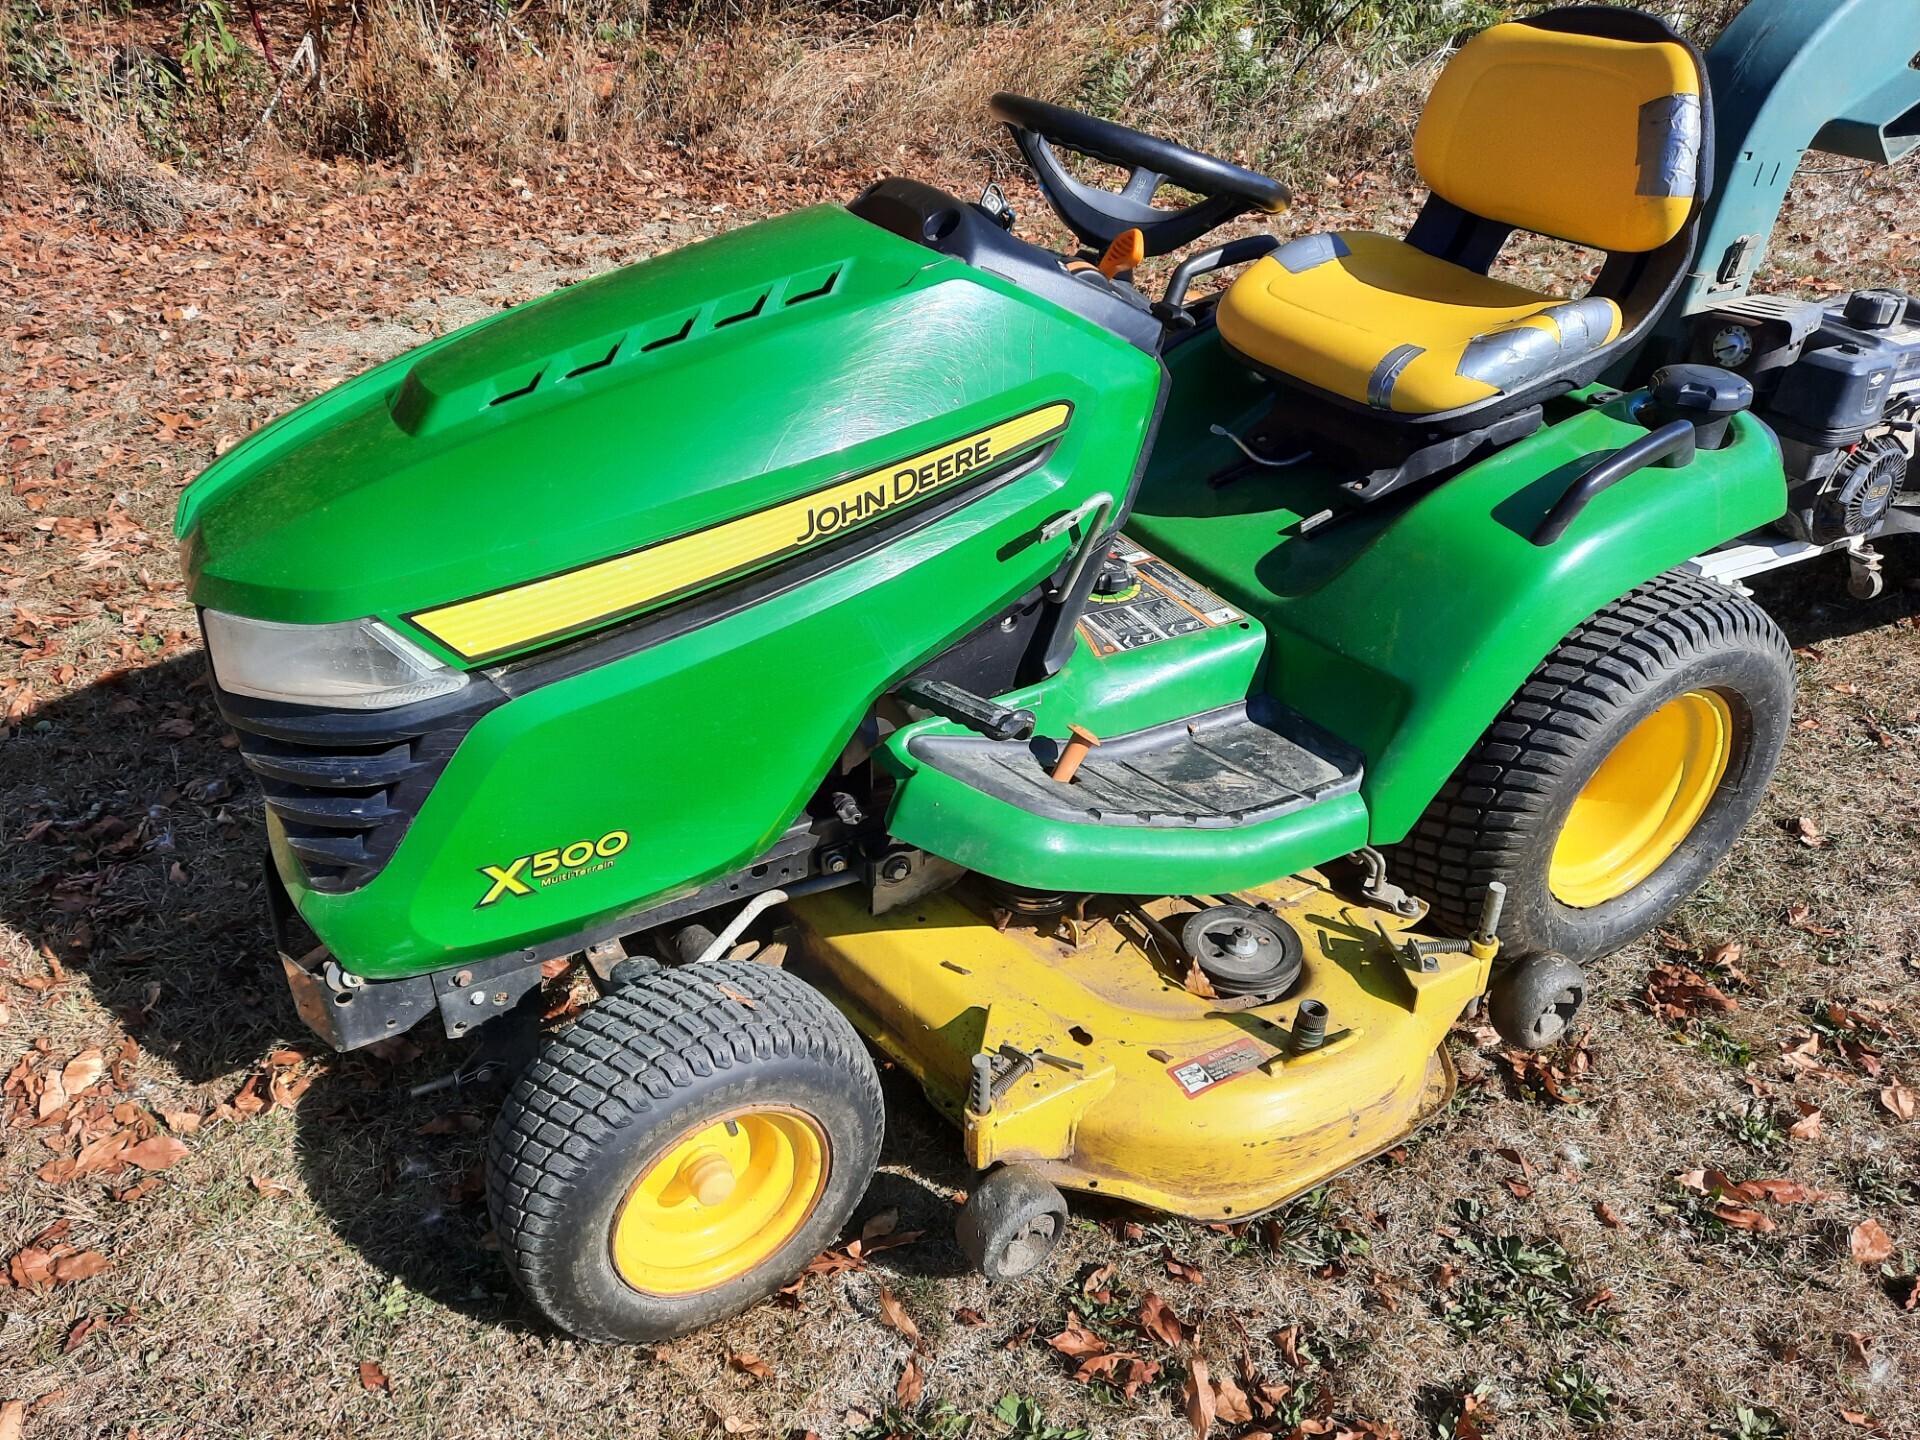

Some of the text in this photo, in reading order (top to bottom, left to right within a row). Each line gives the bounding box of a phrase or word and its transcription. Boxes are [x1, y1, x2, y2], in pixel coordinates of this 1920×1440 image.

[797, 437, 993, 542] JOHN DEERE
[474, 829, 629, 908] X500
